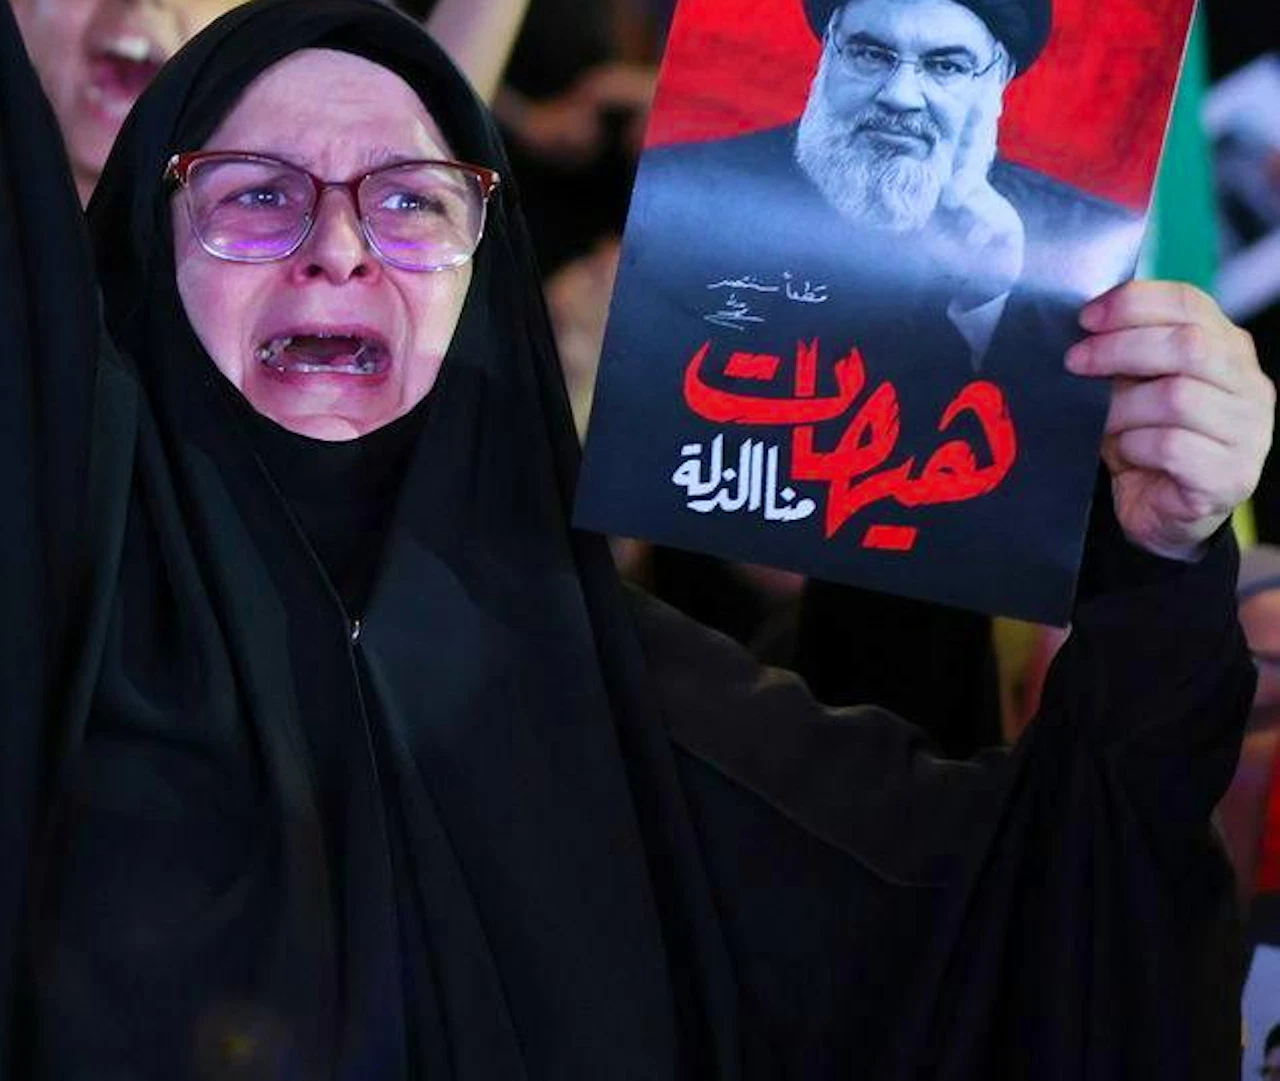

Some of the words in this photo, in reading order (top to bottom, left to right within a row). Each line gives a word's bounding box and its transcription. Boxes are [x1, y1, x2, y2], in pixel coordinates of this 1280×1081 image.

[672, 433, 764, 513] الذلة
[683, 338, 1017, 551] هيهات
[764, 445, 817, 522] منا
